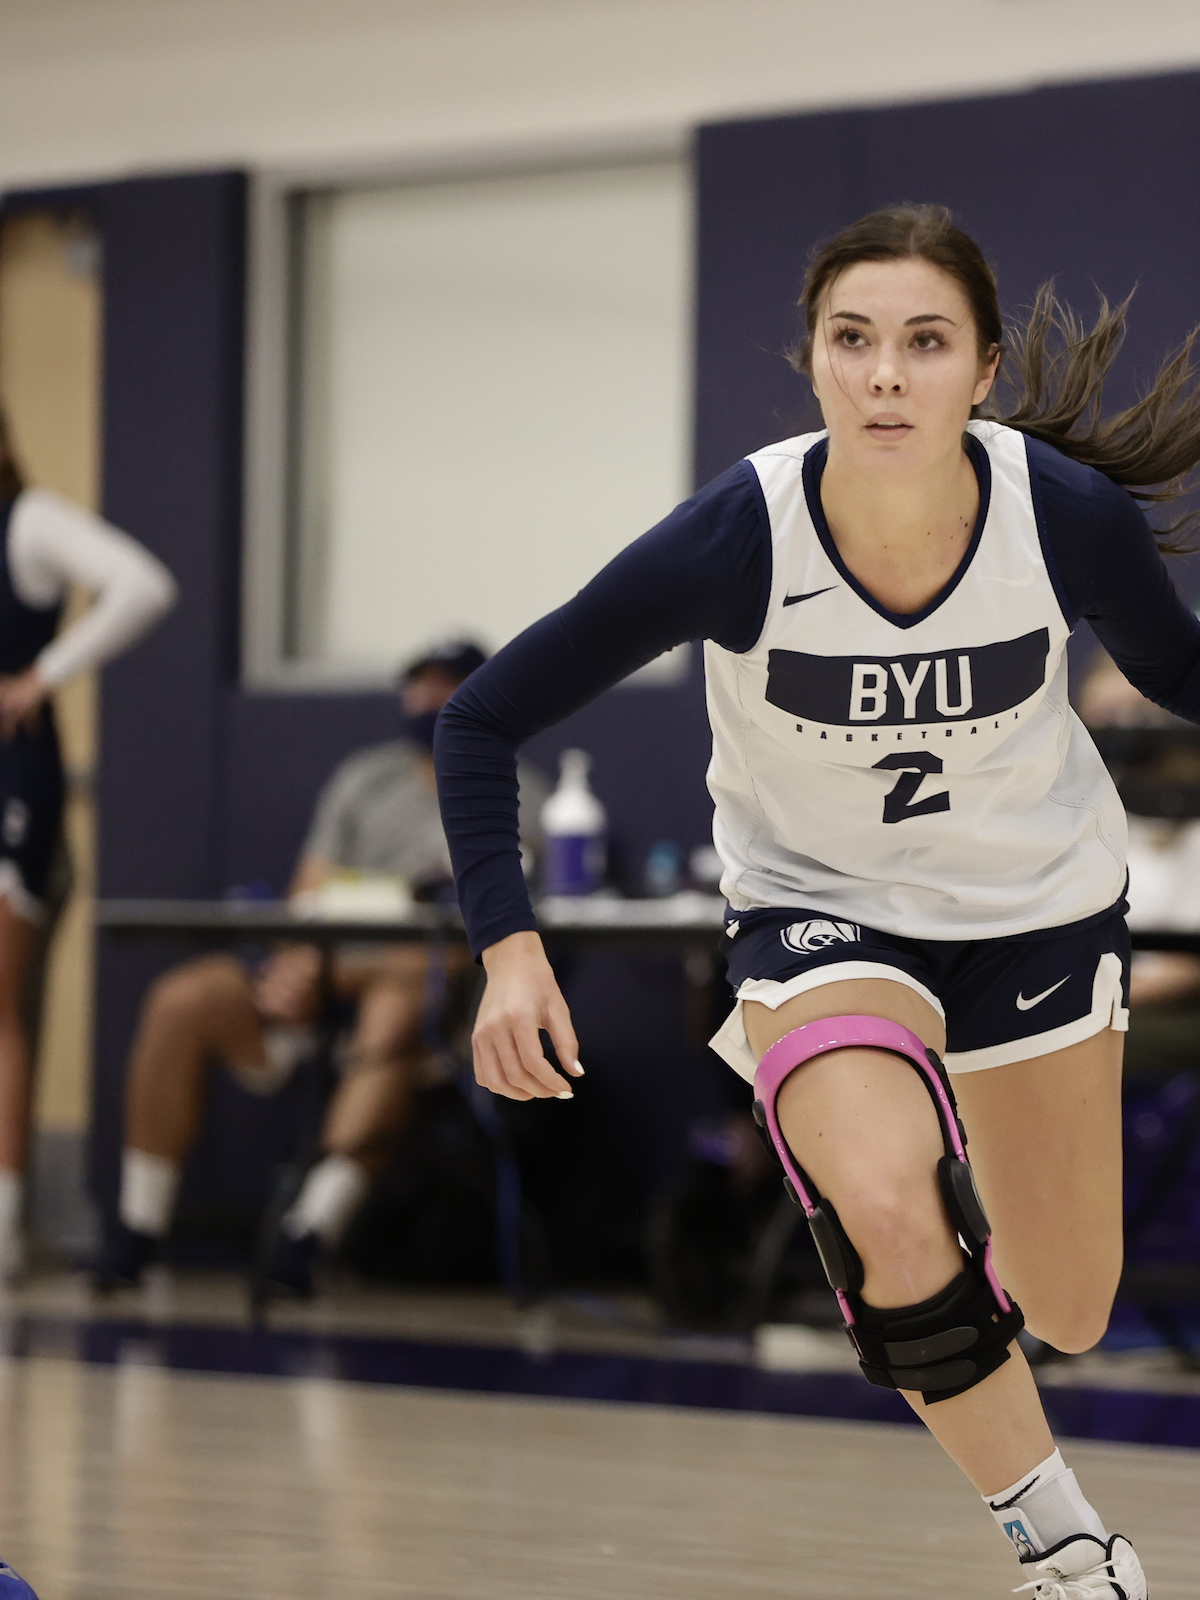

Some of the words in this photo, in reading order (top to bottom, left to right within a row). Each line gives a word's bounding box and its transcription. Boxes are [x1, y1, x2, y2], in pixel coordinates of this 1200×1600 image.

[848, 655, 973, 721] BYU
[796, 711, 1019, 742] BASKETBALL
[871, 750, 951, 824] 2
